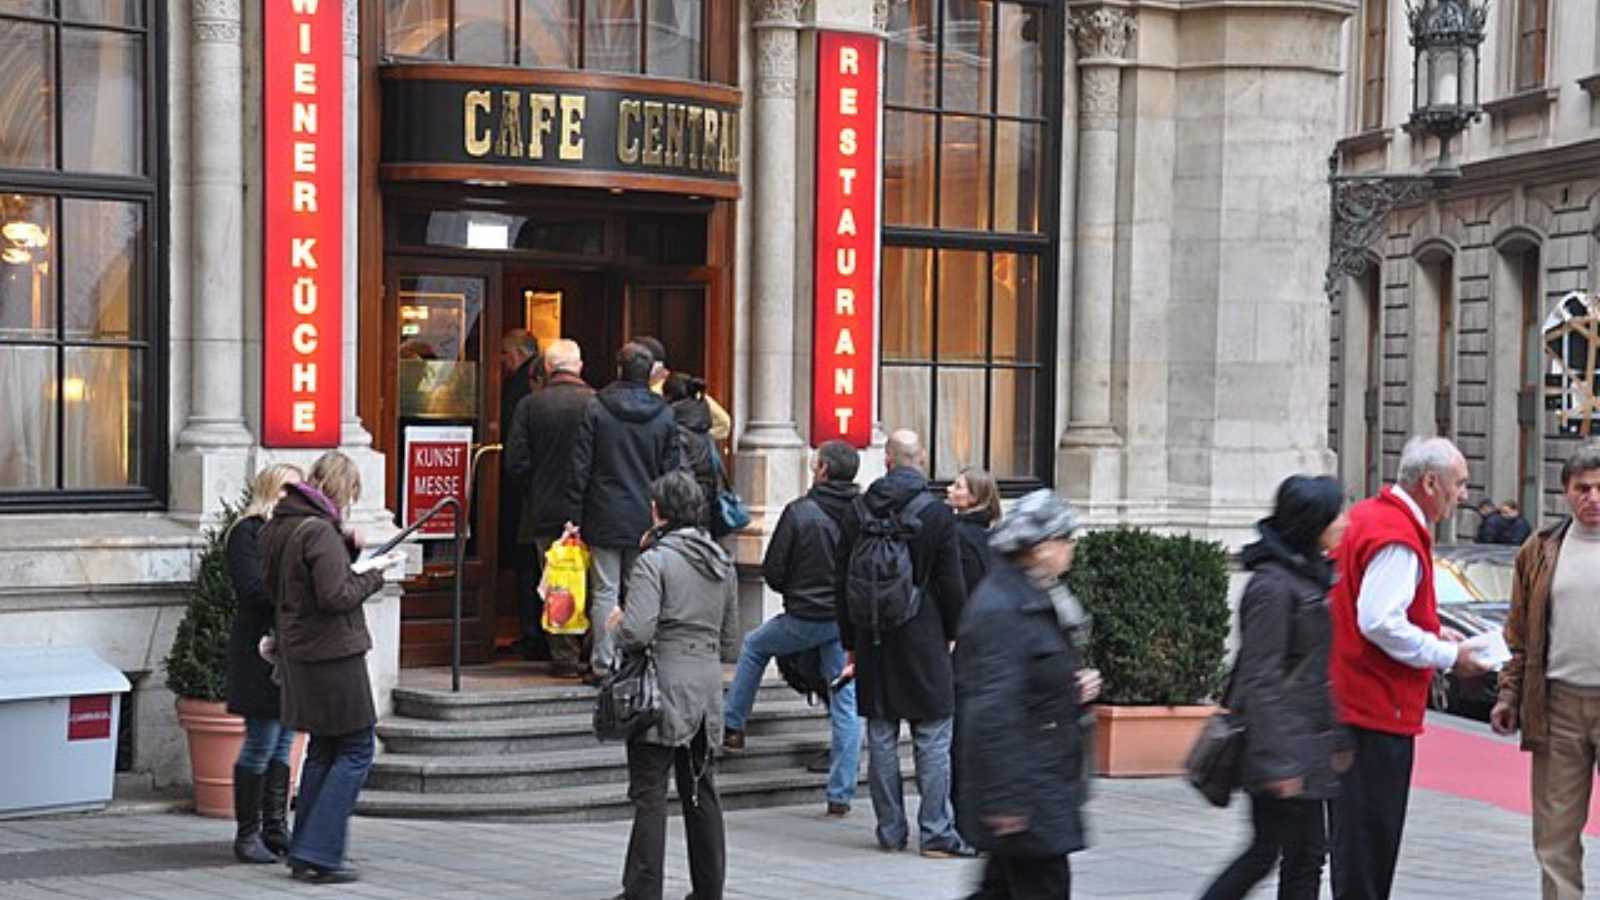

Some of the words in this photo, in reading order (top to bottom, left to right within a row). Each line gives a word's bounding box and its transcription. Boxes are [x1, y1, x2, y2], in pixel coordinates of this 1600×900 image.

[464, 90, 586, 160] CAFE
[834, 46, 859, 435] RESTAURANT
[291, 237, 319, 432] KÜCHE
[414, 446, 462, 468] KUNST
[414, 475, 460, 496] MESSE
